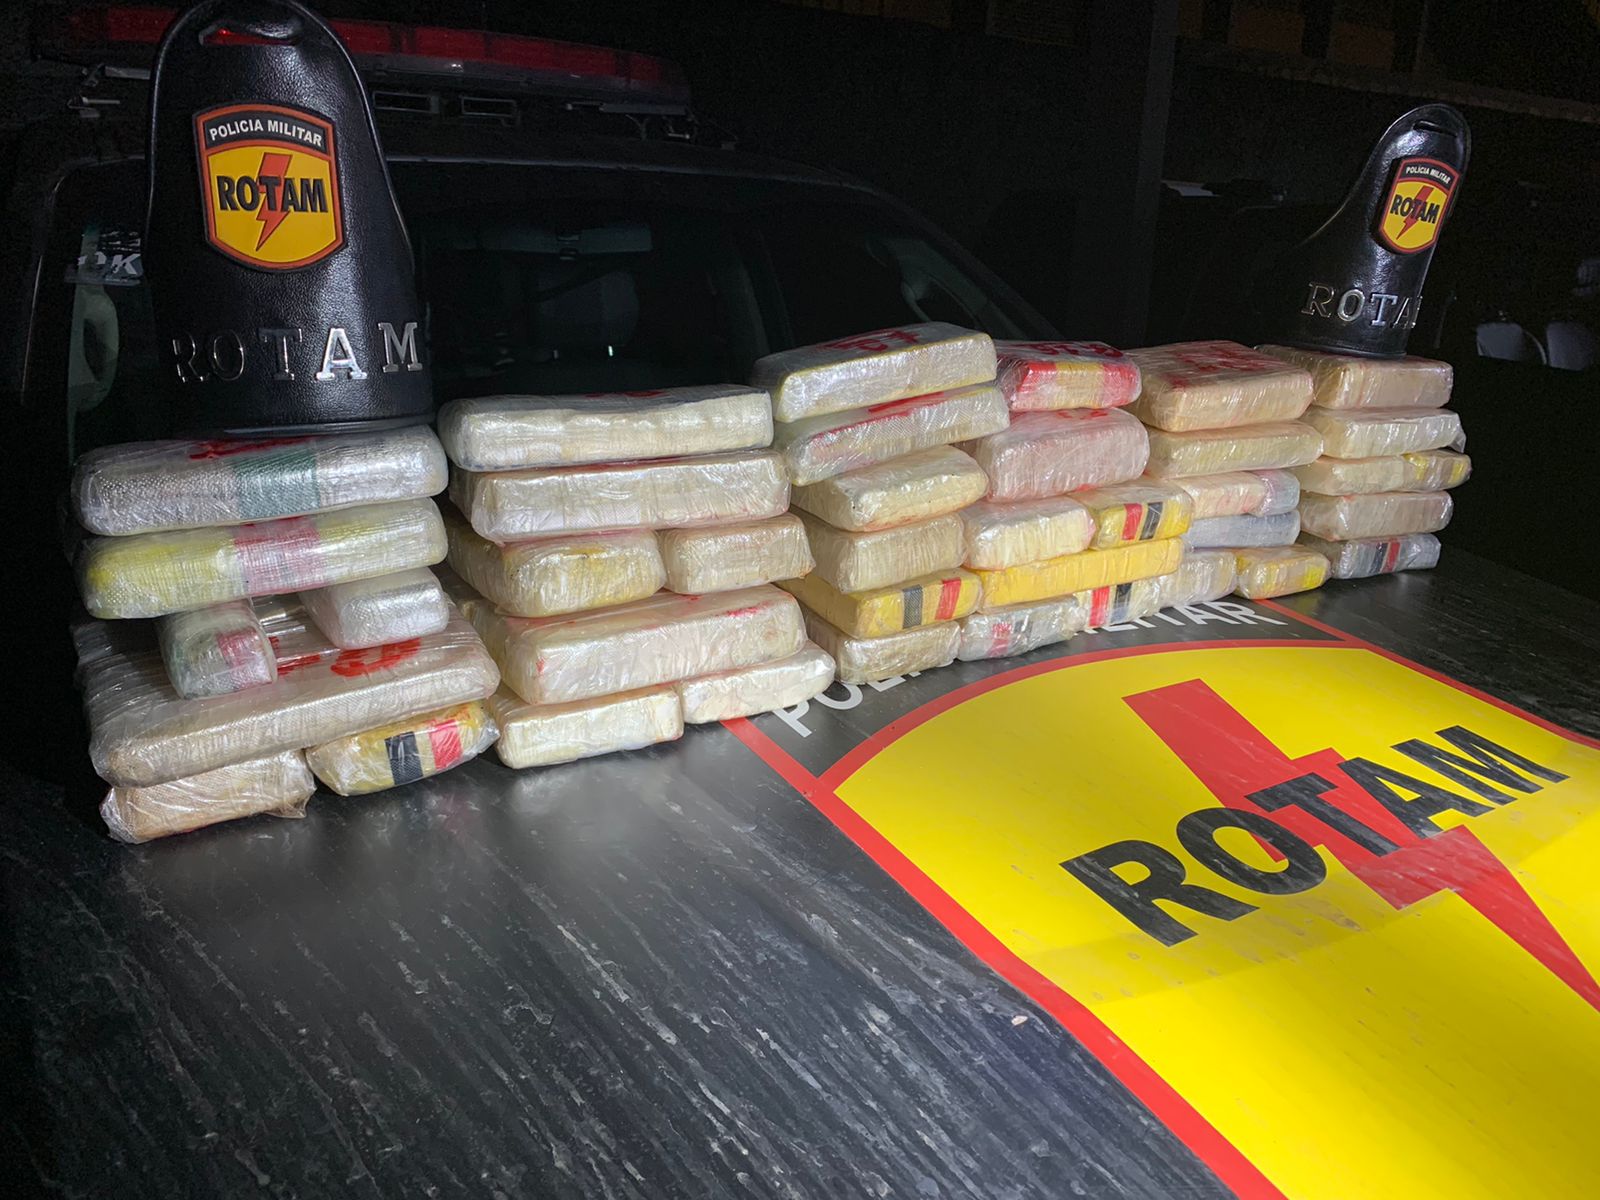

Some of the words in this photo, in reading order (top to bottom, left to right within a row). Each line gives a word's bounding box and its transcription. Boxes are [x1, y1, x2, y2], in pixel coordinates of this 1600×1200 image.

[209, 119, 264, 141] POLICIA
[267, 119, 323, 147] MILITAR
[216, 175, 328, 213] ROTAM
[1390, 194, 1441, 224] ROTAM
[172, 321, 423, 384] ROTAM
[1059, 725, 1571, 947] ROTAM
